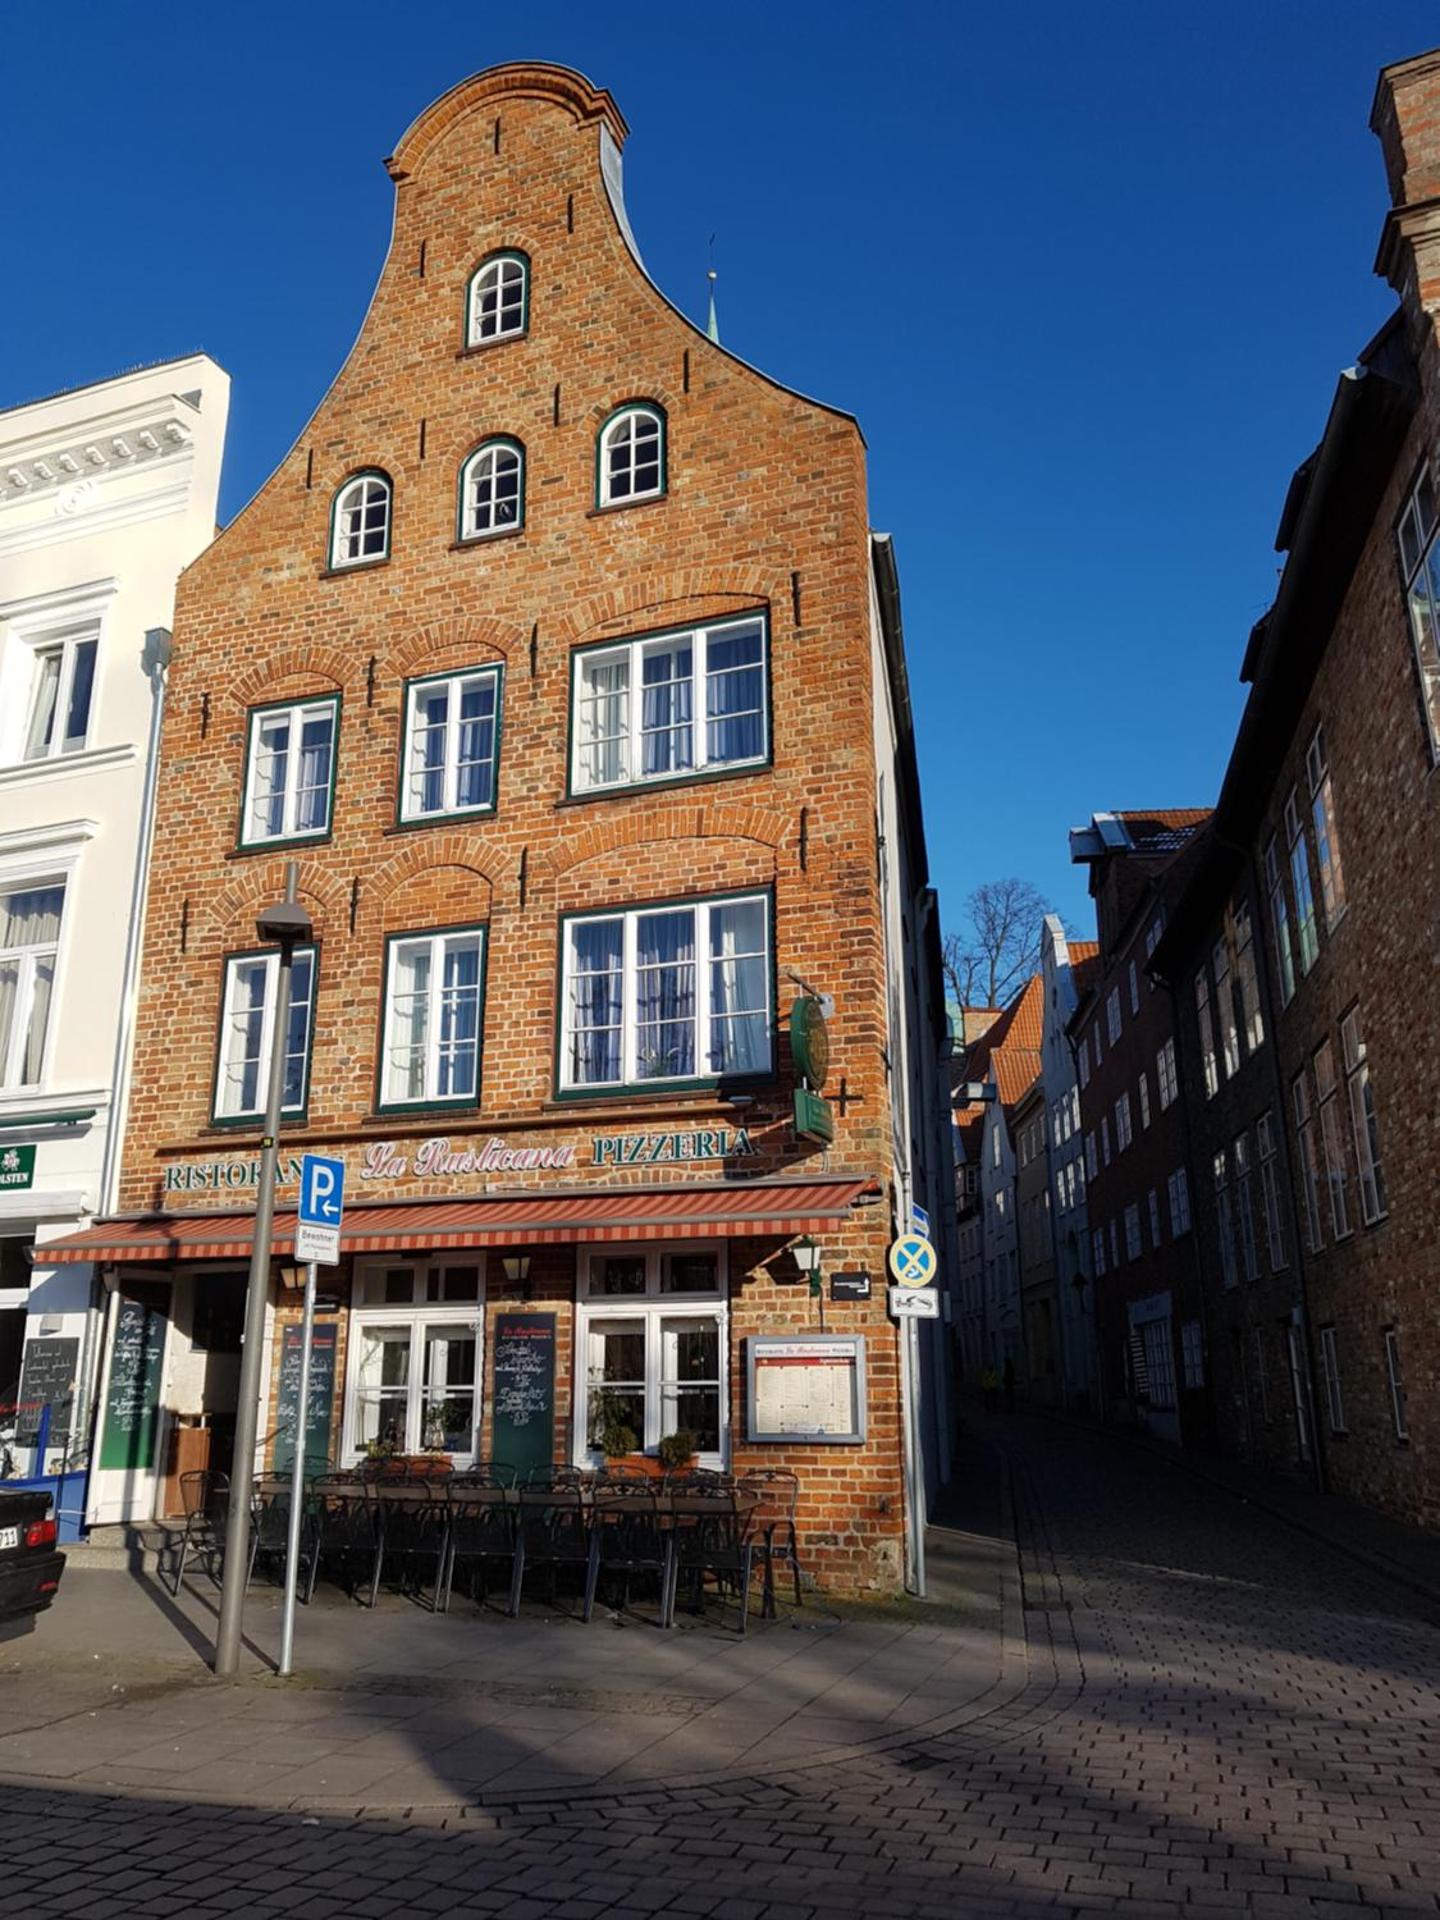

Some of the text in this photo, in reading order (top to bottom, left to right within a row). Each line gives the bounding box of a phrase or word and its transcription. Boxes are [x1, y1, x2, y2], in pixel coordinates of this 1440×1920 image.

[162, 1128, 756, 1191] RISTORAN La Rusticana PIZZERIA
[310, 1164, 334, 1215] P
